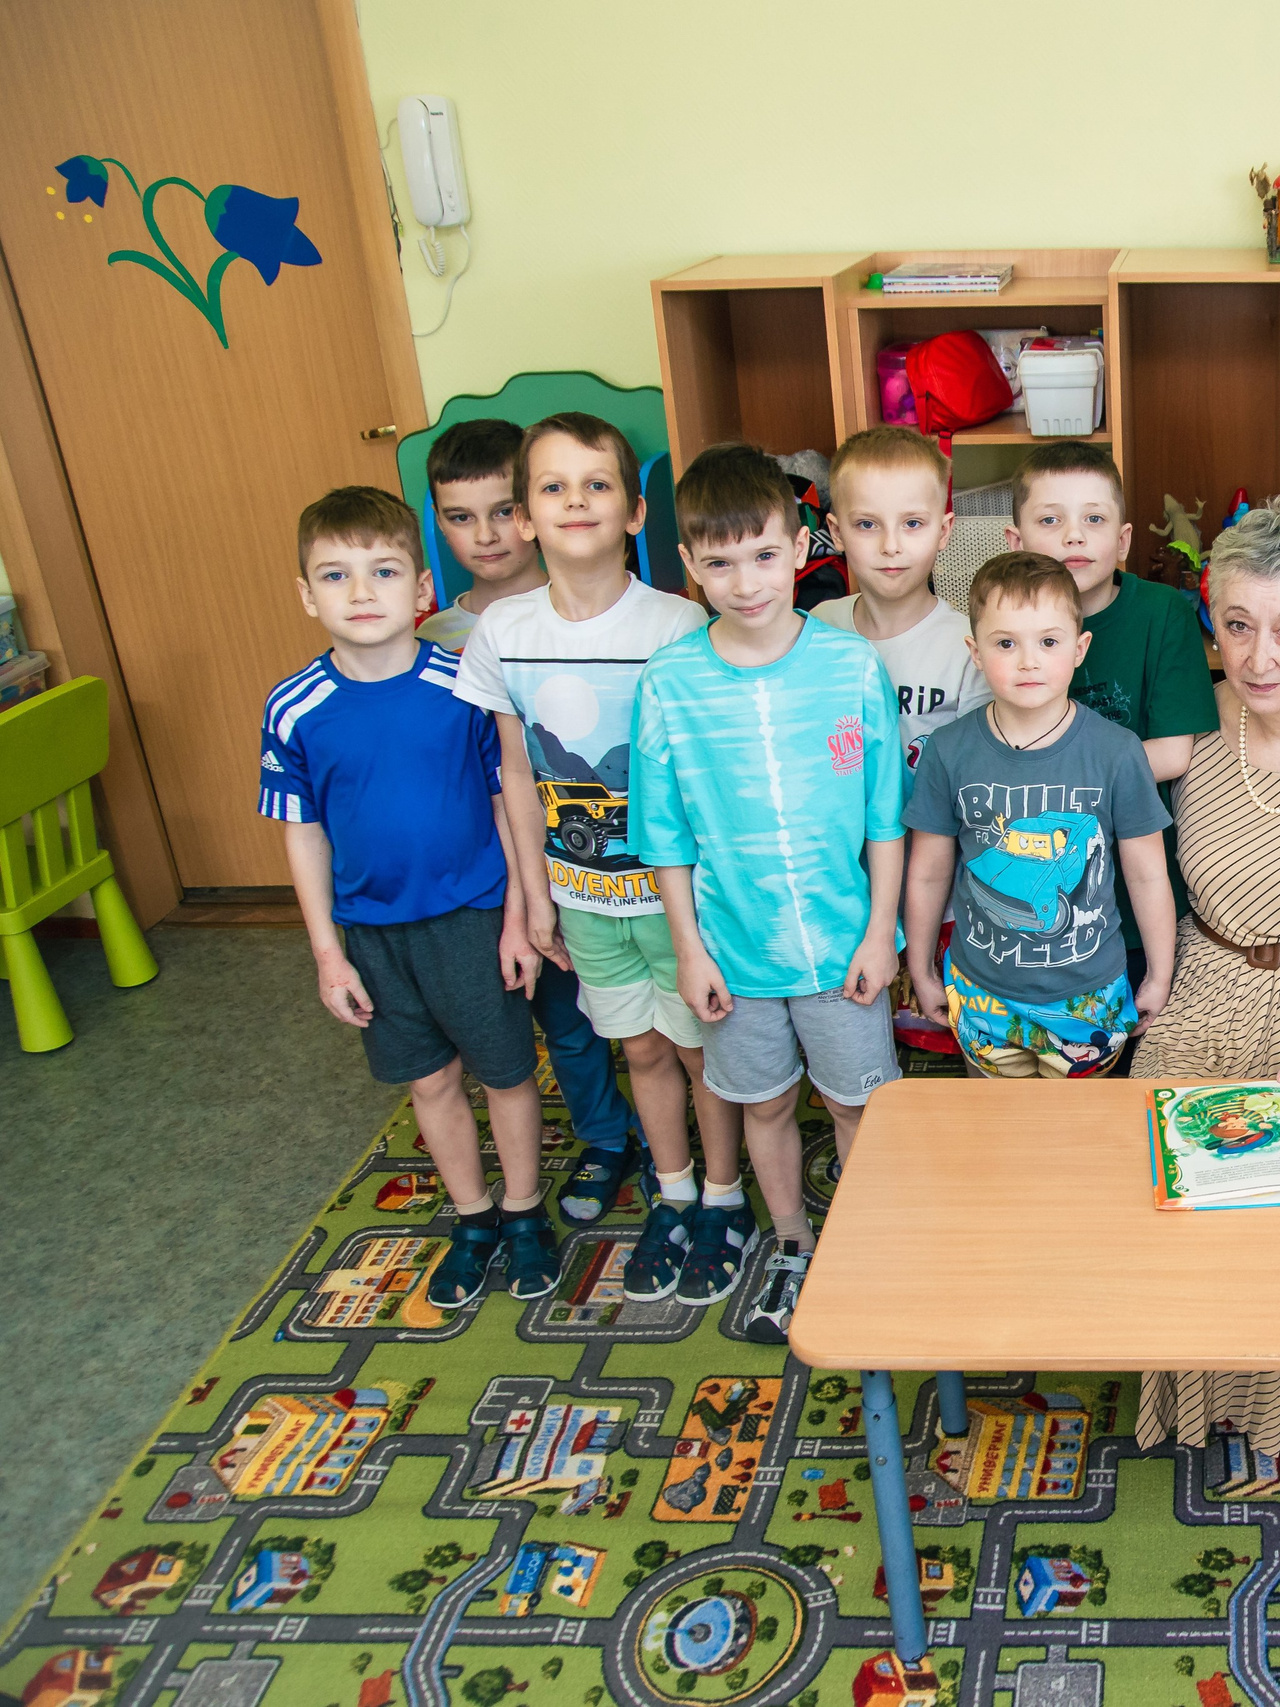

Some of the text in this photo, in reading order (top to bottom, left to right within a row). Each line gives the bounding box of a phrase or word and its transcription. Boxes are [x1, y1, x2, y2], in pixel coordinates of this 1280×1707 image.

[570, 891, 612, 906] CREATIVE
[614, 897, 638, 907] LINE
[247, 1419, 307, 1490] УНИВЕРМАГ
[977, 1420, 1008, 1494] УНИВЕРМАГ
